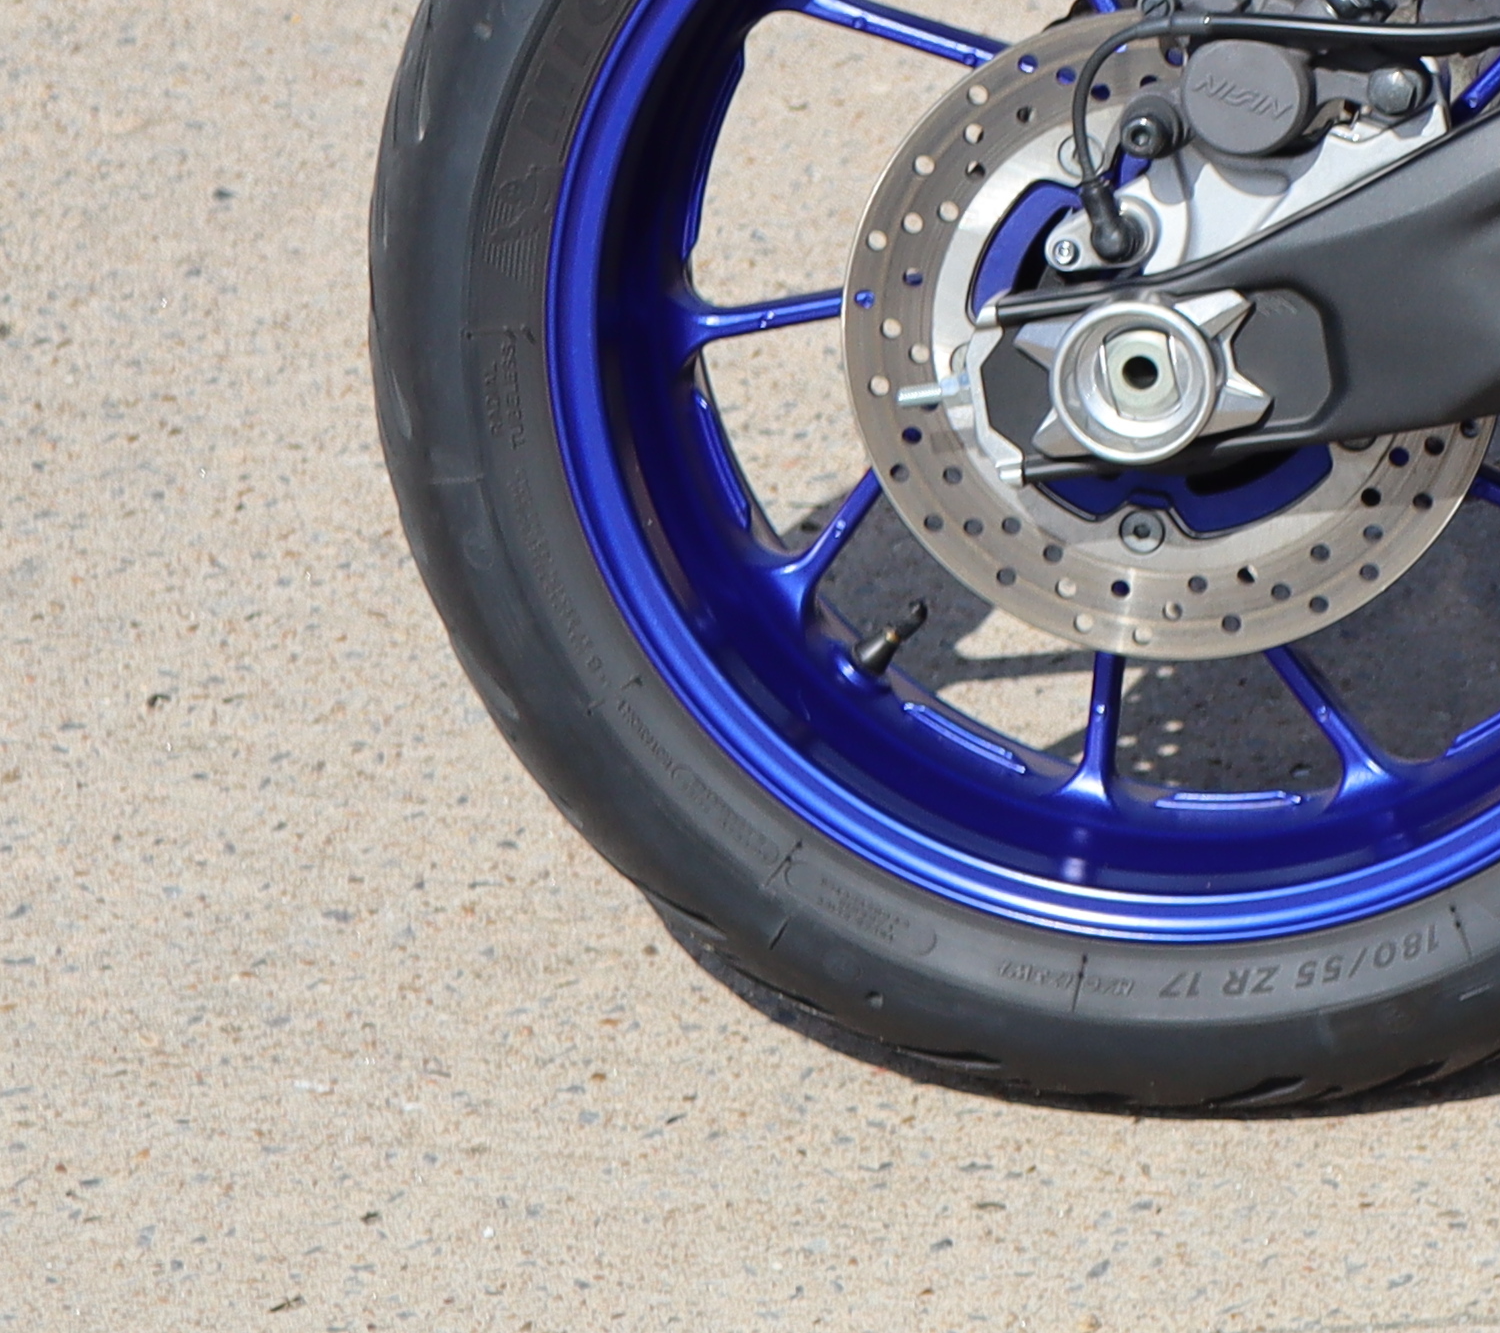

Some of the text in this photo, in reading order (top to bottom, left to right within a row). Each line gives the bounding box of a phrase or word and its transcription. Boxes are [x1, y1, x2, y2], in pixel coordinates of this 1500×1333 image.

[1295, 920, 1446, 991] 180/55
[1157, 970, 1203, 1001] 17
[1222, 963, 1285, 1000] ZR
